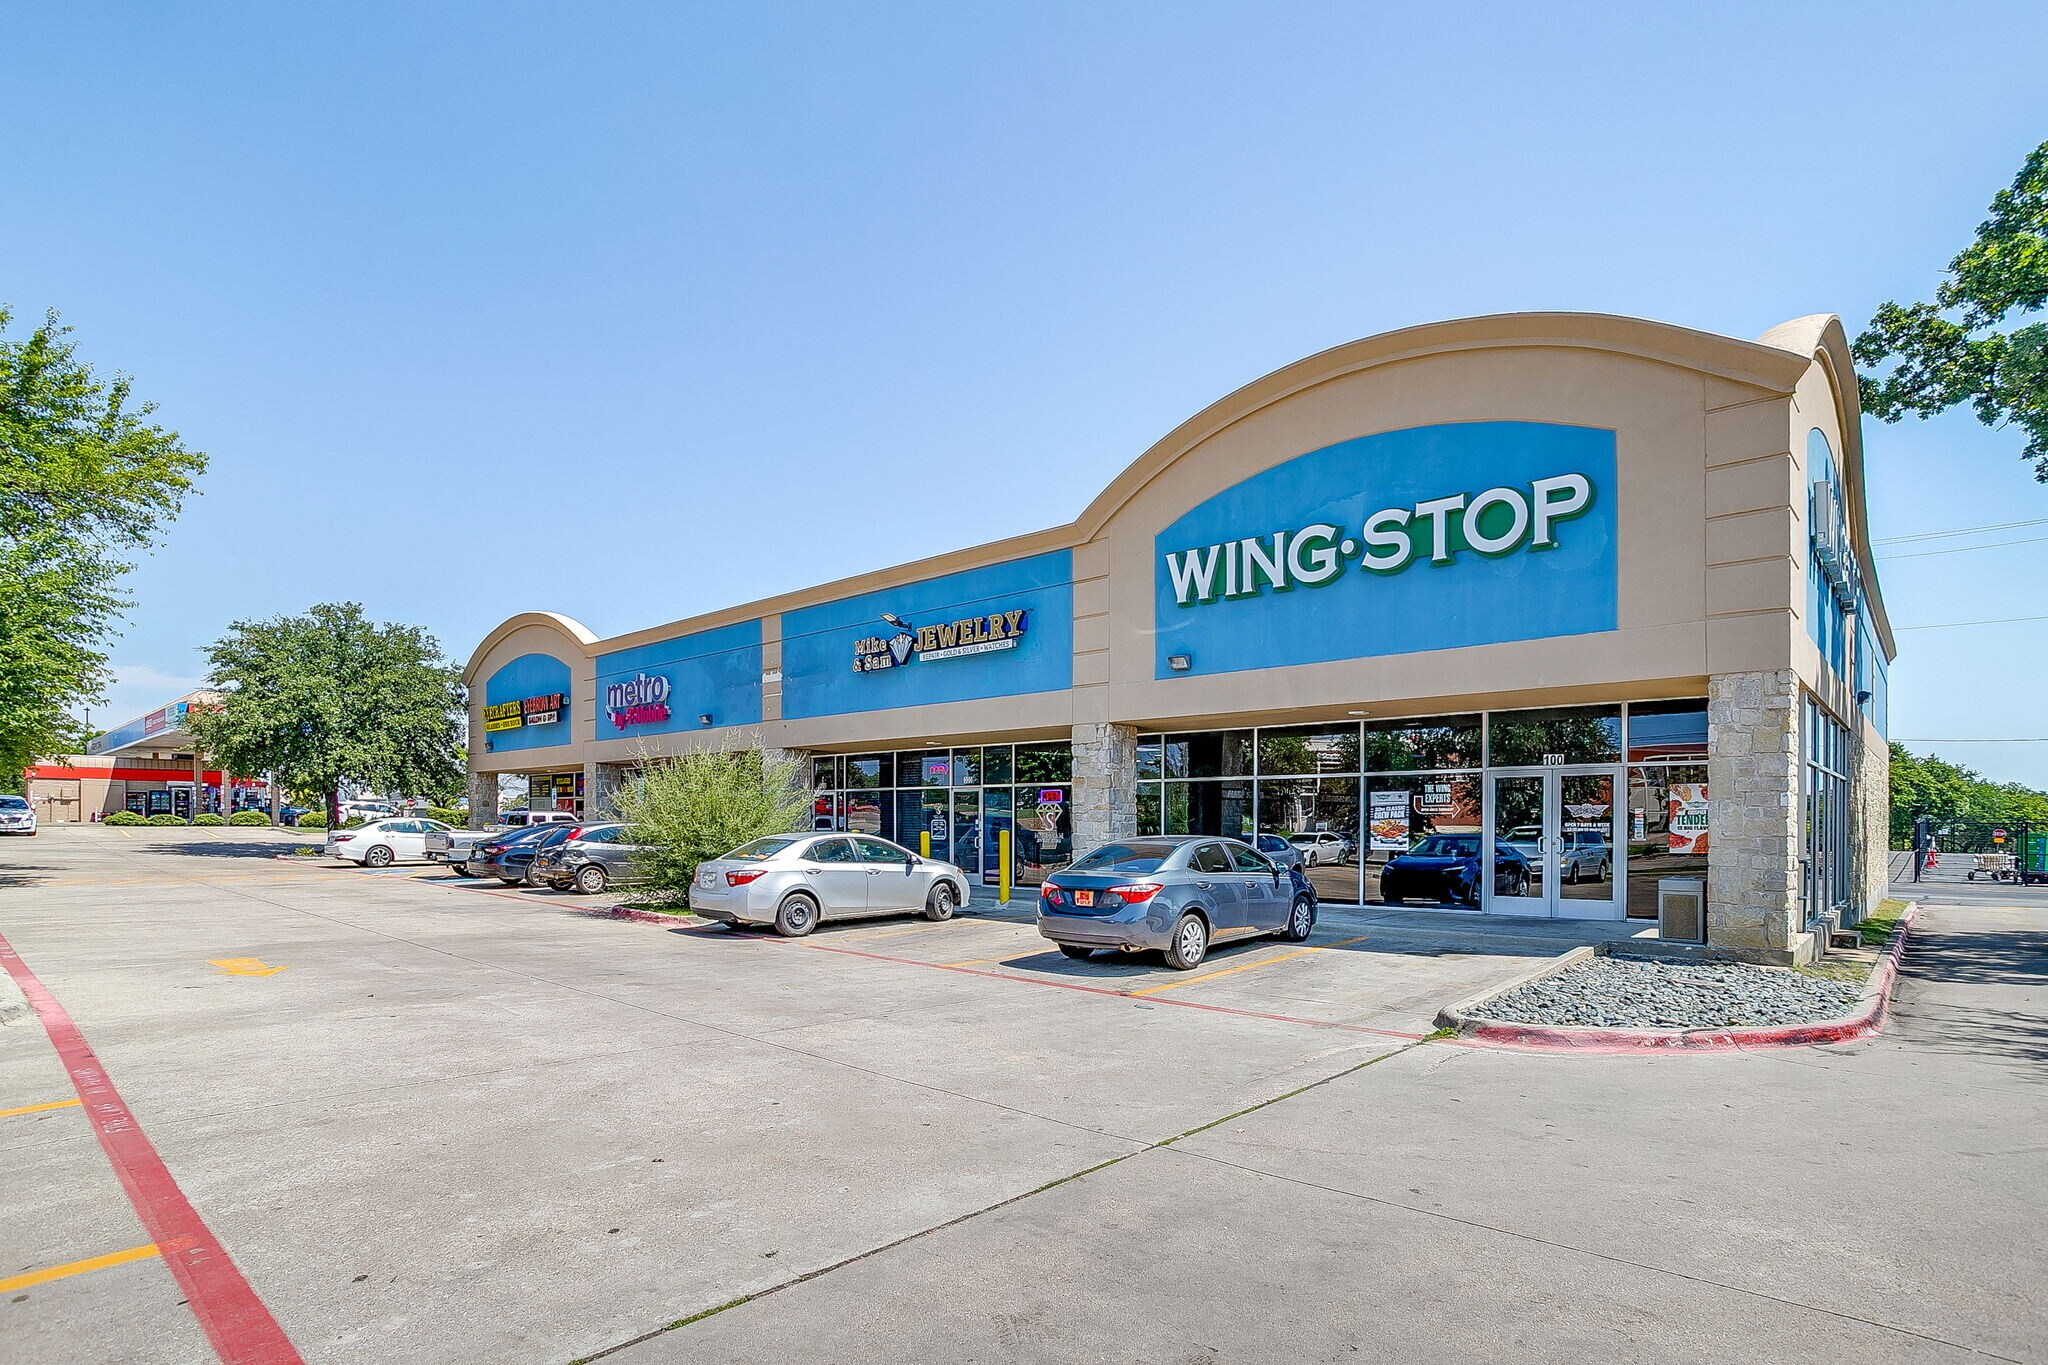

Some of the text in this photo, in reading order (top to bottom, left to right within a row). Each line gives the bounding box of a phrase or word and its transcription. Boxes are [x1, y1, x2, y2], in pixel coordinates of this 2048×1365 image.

[913, 609, 1023, 652] JEWELRY
[854, 636, 888, 656] Mike
[922, 651, 940, 660] REPAIR
[943, 648, 958, 657] GOLD
[962, 645, 981, 654] SILVER
[983, 641, 1010, 651] WATCHES
[852, 654, 892, 672] & Sam
[607, 673, 667, 707] metro
[550, 694, 561, 709] ART
[614, 704, 669, 731] by T-Mobile
[1543, 754, 1563, 766] 100
[1424, 784, 1452, 793] THE WING
[1424, 793, 1451, 803] EXPERTS
[1390, 810, 1405, 819] PACK
